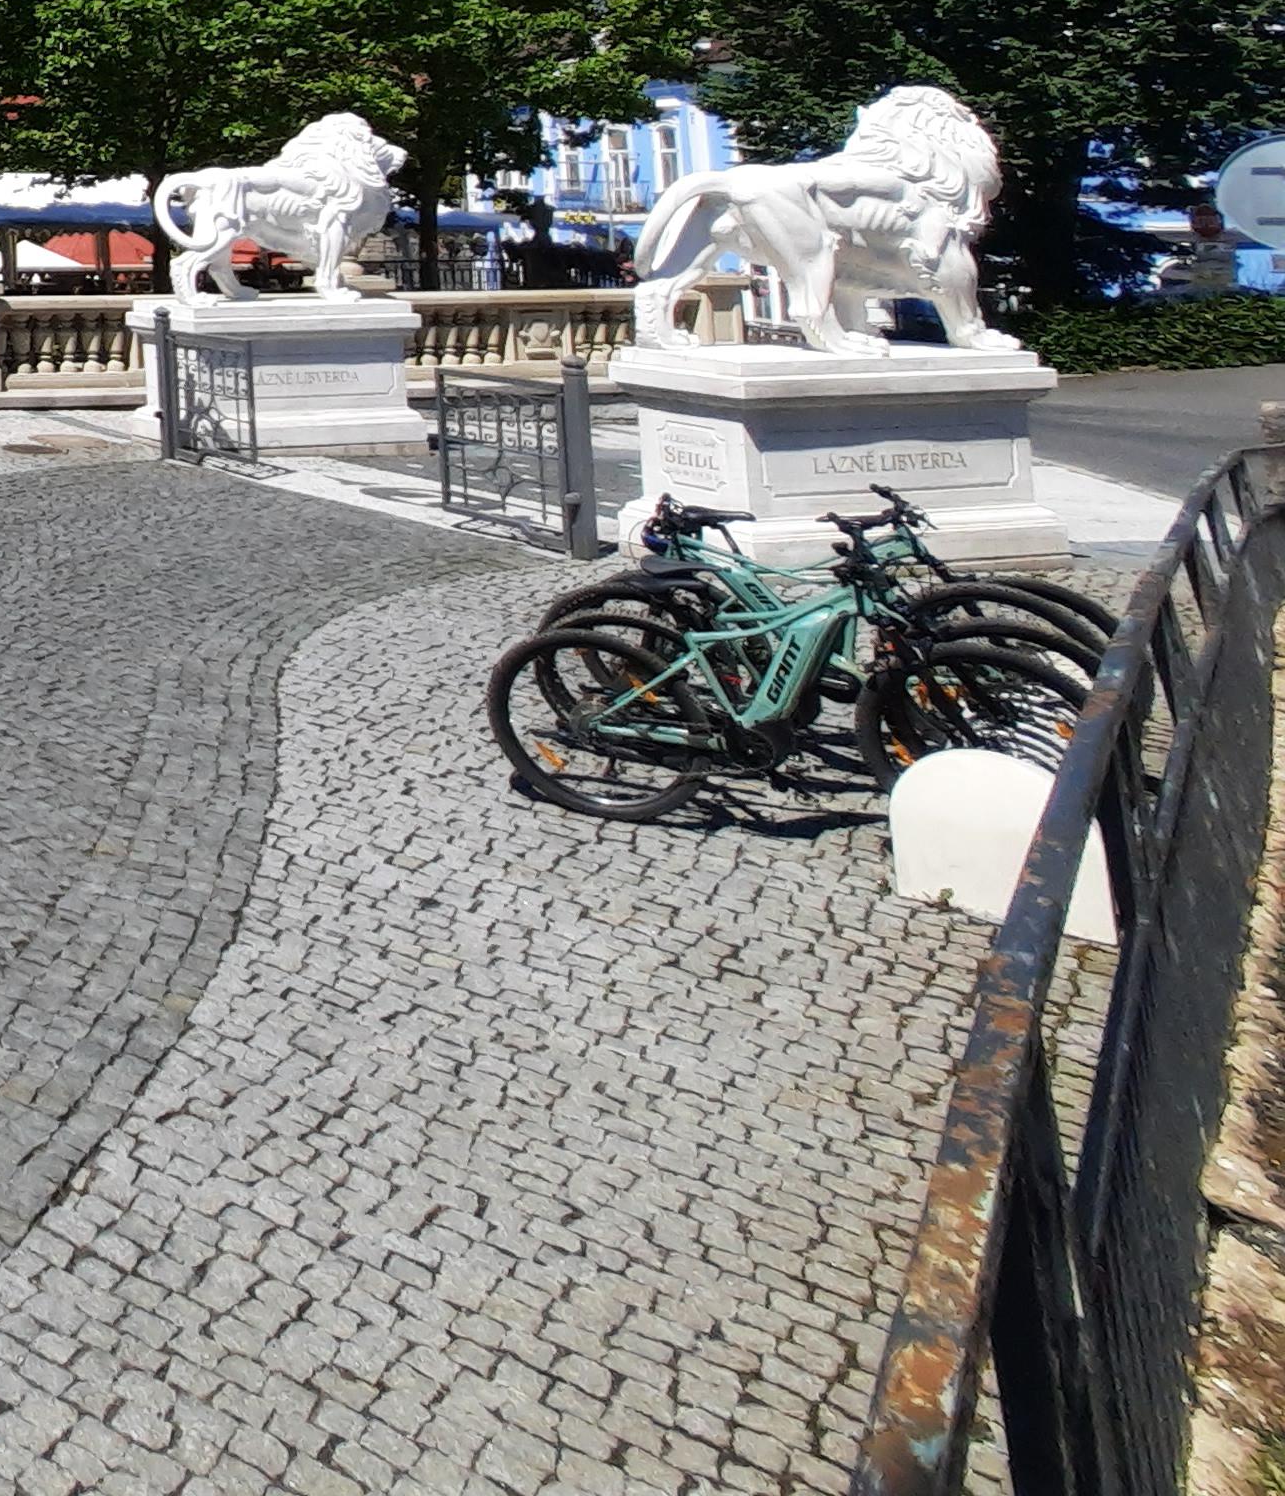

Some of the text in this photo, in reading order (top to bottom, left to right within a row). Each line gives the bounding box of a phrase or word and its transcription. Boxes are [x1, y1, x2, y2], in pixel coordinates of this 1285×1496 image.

[663, 445, 720, 471] SEIDL
[879, 451, 968, 472] LIBVERDA
[766, 634, 801, 705] GIANT
